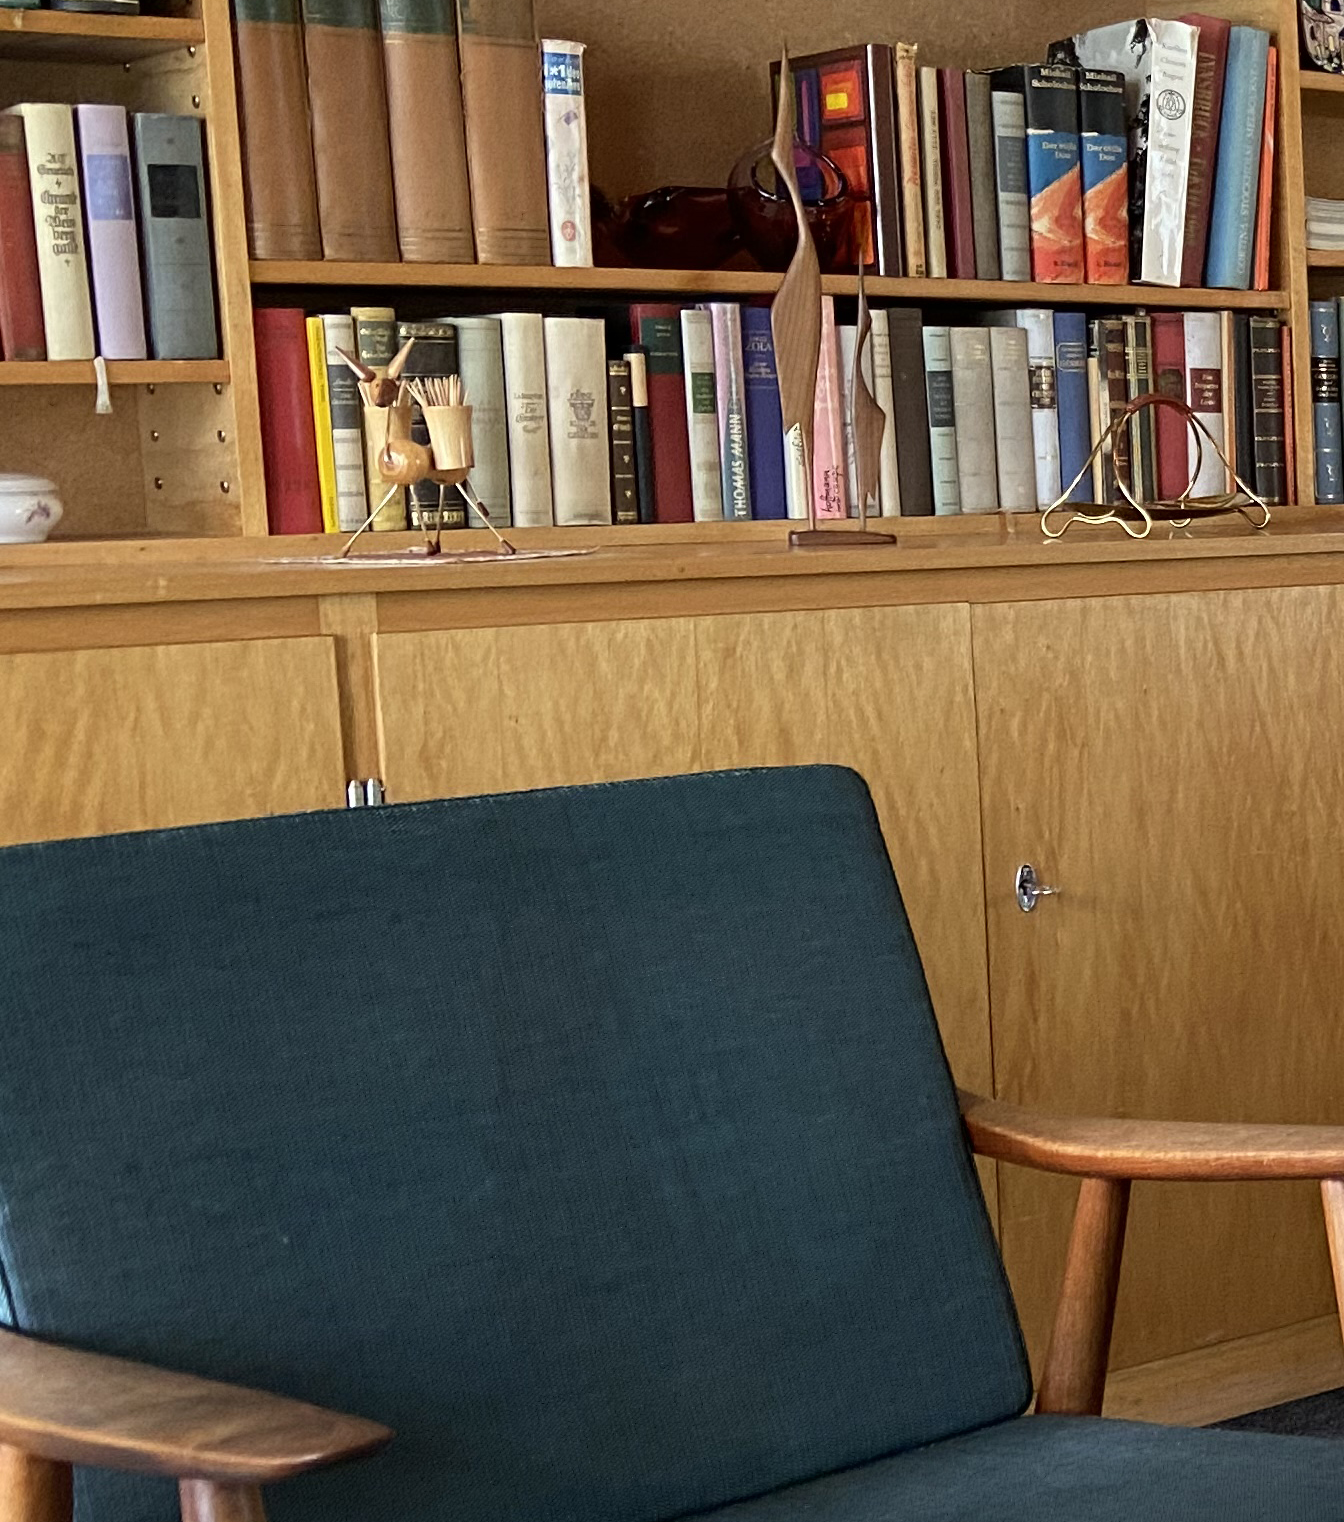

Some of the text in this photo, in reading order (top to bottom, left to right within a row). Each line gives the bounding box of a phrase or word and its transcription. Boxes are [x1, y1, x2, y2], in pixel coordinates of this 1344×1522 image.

[746, 341, 772, 352] ZOLA
[728, 413, 747, 518] THOMAS MANN
